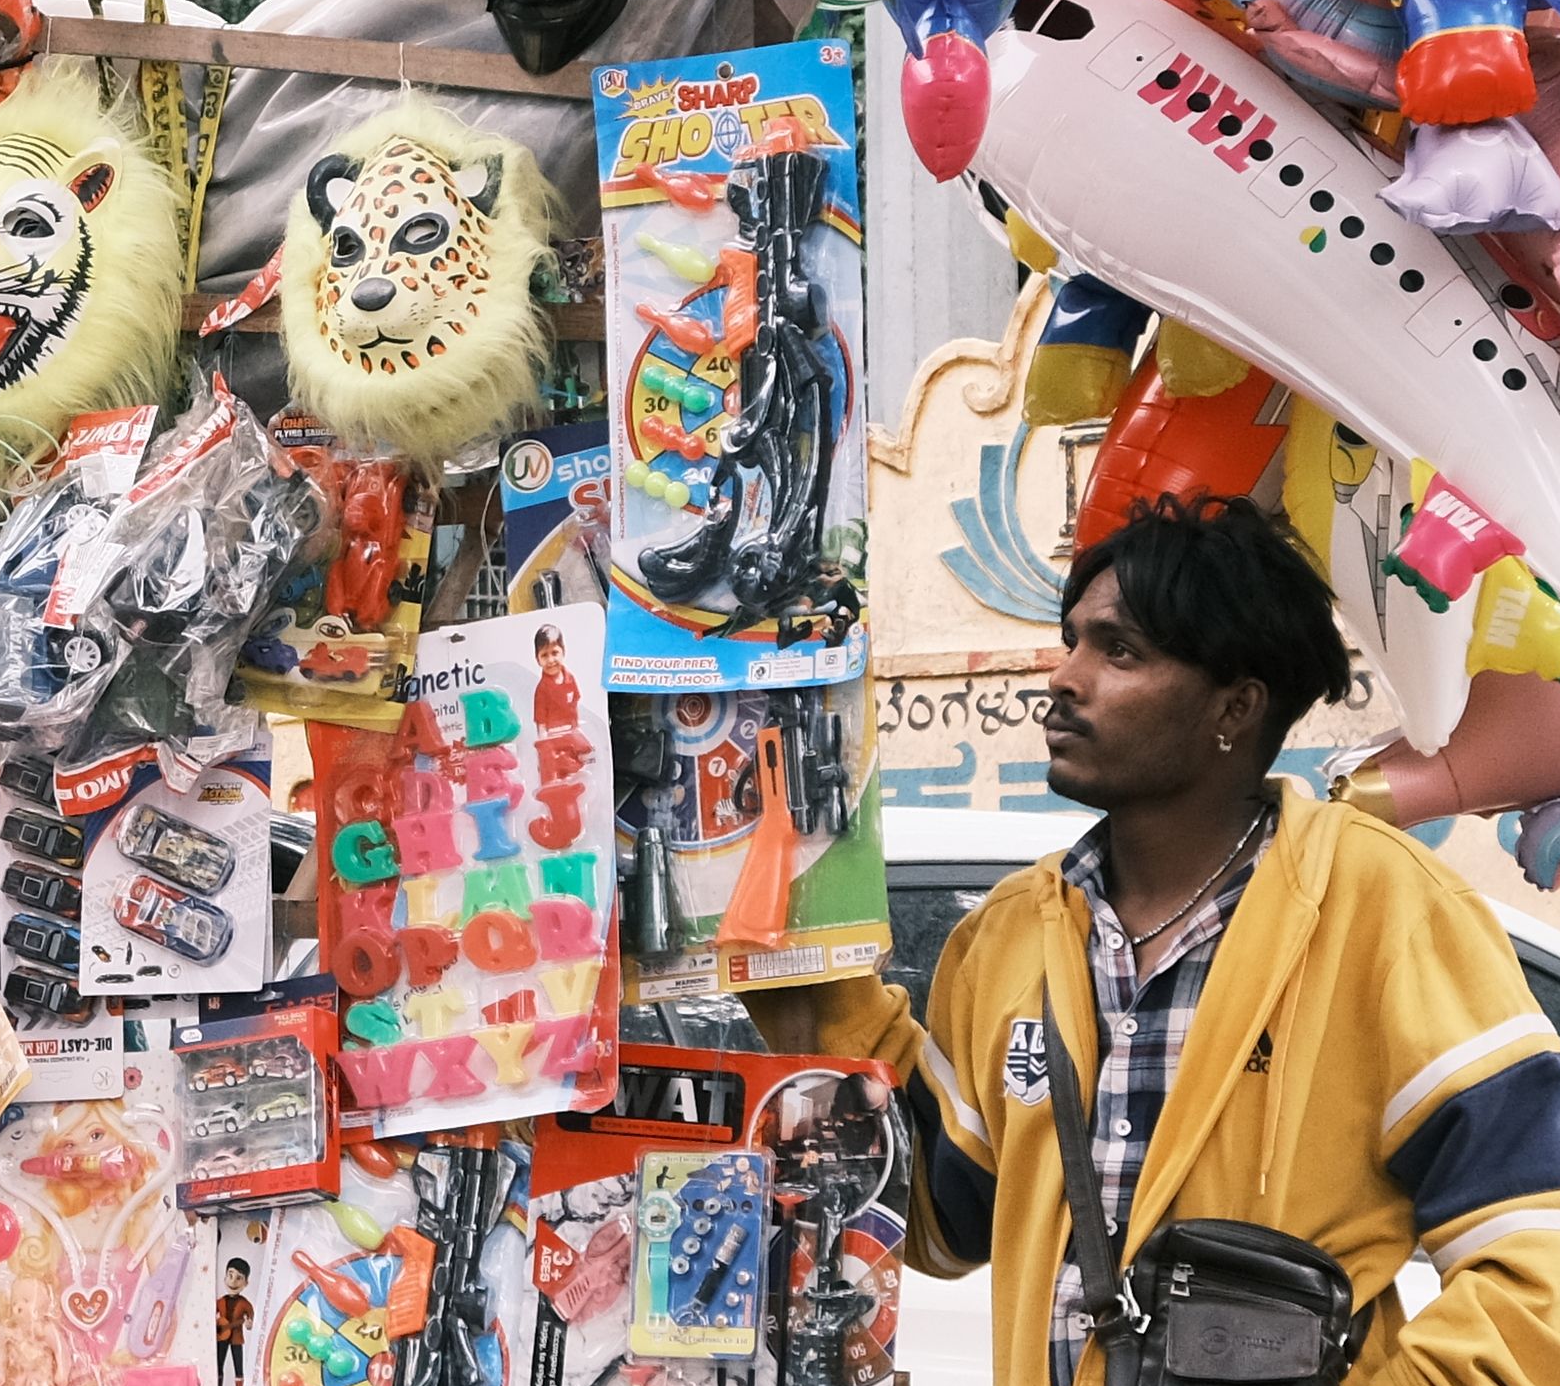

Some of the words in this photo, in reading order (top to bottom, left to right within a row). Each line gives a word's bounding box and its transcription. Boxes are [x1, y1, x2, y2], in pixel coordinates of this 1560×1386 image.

[634, 90, 670, 110] BRAVE
[677, 75, 759, 111] SHARP
[1138, 51, 1279, 175] TAM
[706, 357, 730, 373] 40
[644, 397, 669, 413] 30
[1425, 490, 1490, 542] TAM
[1486, 586, 1530, 649] TAM
[612, 657, 646, 669] FIND
[646, 657, 681, 670] YOUR
[682, 657, 718, 671] PREY,
[611, 673, 635, 684] AIM
[635, 673, 654, 684] AT
[675, 673, 723, 685] SHOOT.
[746, 722, 754, 737] 2
[712, 760, 722, 774] 7
[199, 787, 242, 802] ACTION
[333, 820, 400, 883] G
[391, 813, 464, 875] H
[465, 798, 521, 861] I
[529, 783, 586, 850] J
[331, 927, 402, 997] O
[38, 1042, 57, 1054] CAR
[59, 1038, 112, 1052] DIE-CAST
[540, 1246, 552, 1282] AGES
[550, 1248, 572, 1281] 3+
[284, 1345, 310, 1363] 30
[547, 1326, 562, 1379] Accompany
[372, 1363, 392, 1380] 10
